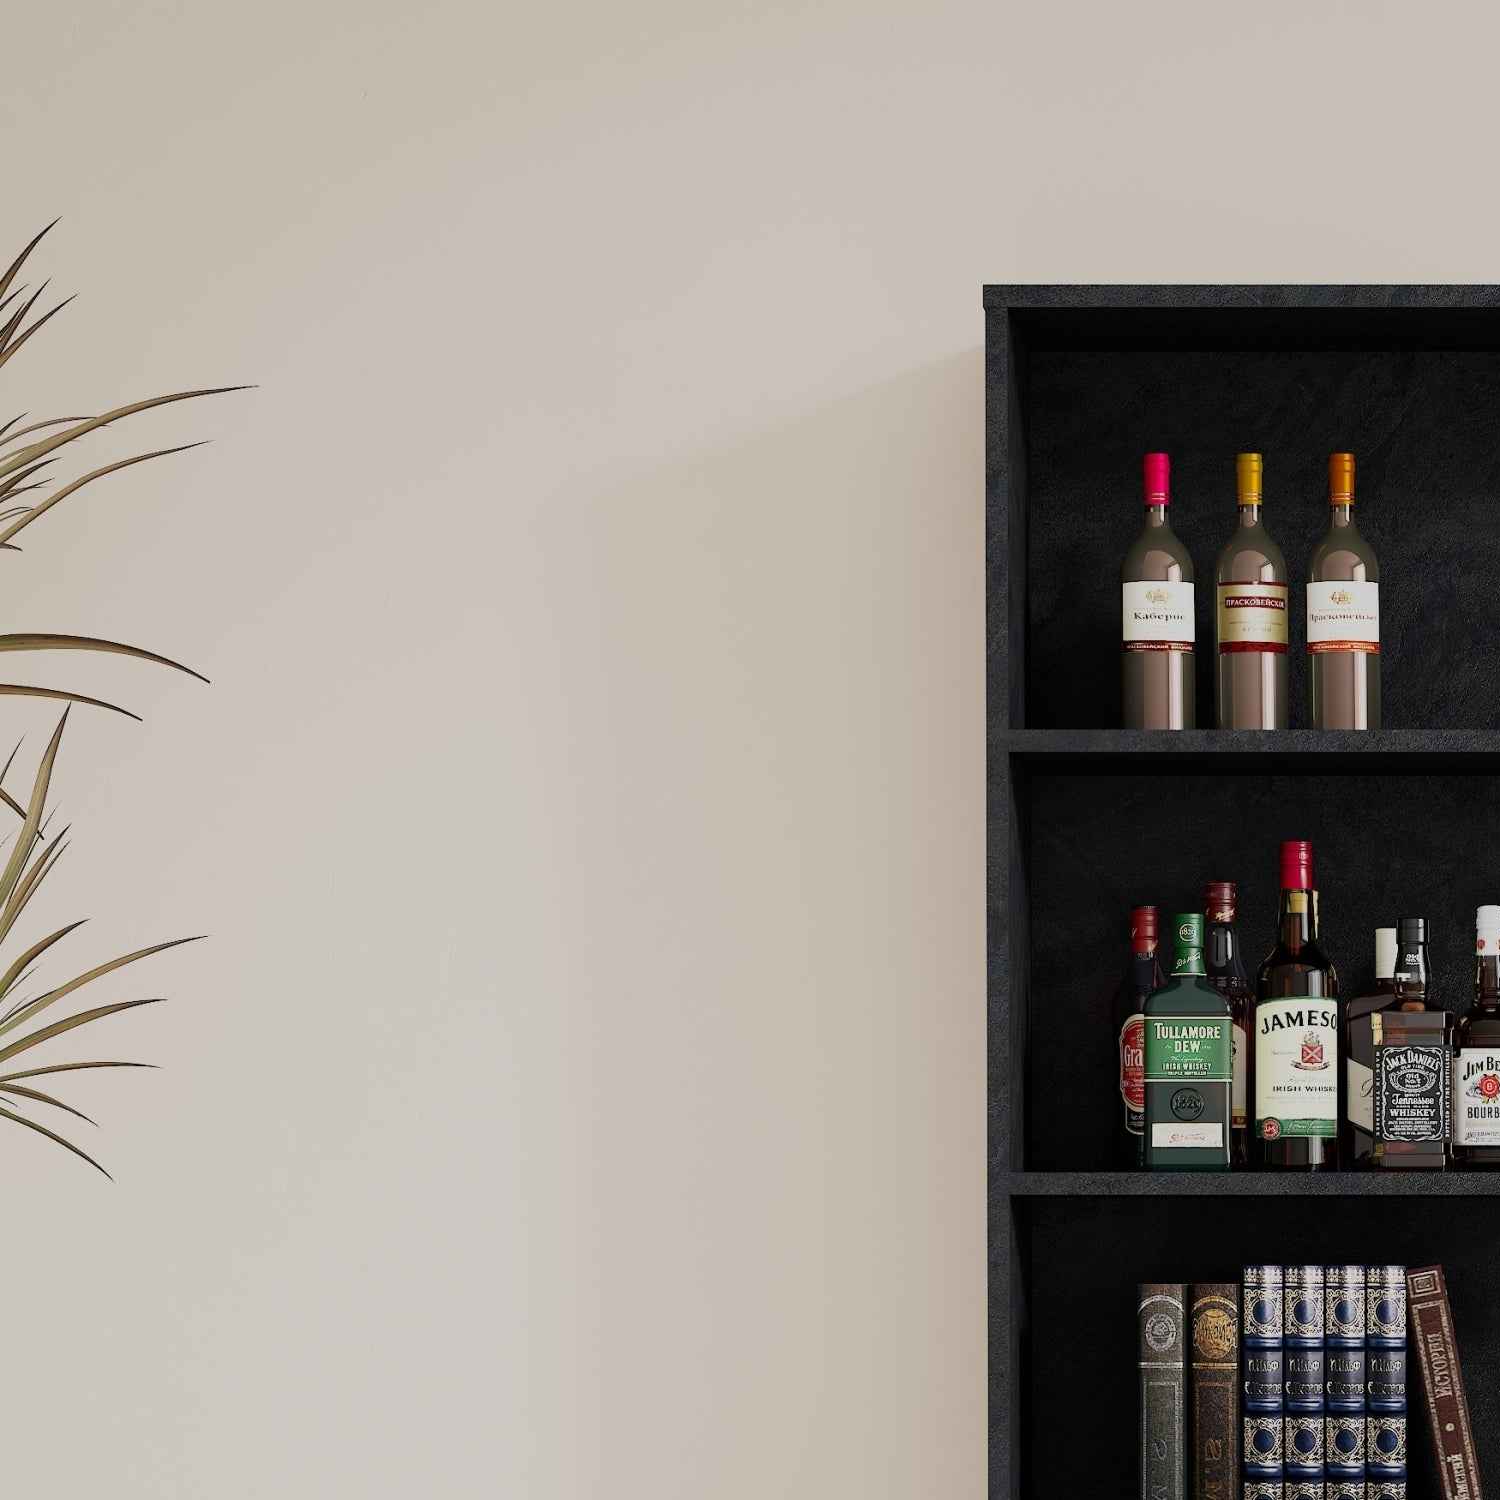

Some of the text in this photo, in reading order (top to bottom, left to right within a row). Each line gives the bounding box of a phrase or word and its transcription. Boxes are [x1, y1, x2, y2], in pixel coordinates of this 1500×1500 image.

[1154, 1022, 1221, 1039] TULLAMORE
[1174, 1041, 1201, 1053] DEW
[1162, 1062, 1212, 1071] IRISH WHISKEY
[1386, 1053, 1407, 1071] JACK
[1463, 1061, 1484, 1080] JIM
[1391, 1093, 1435, 1105] Tennessee
[1389, 1108, 1436, 1117] WHISKEY
